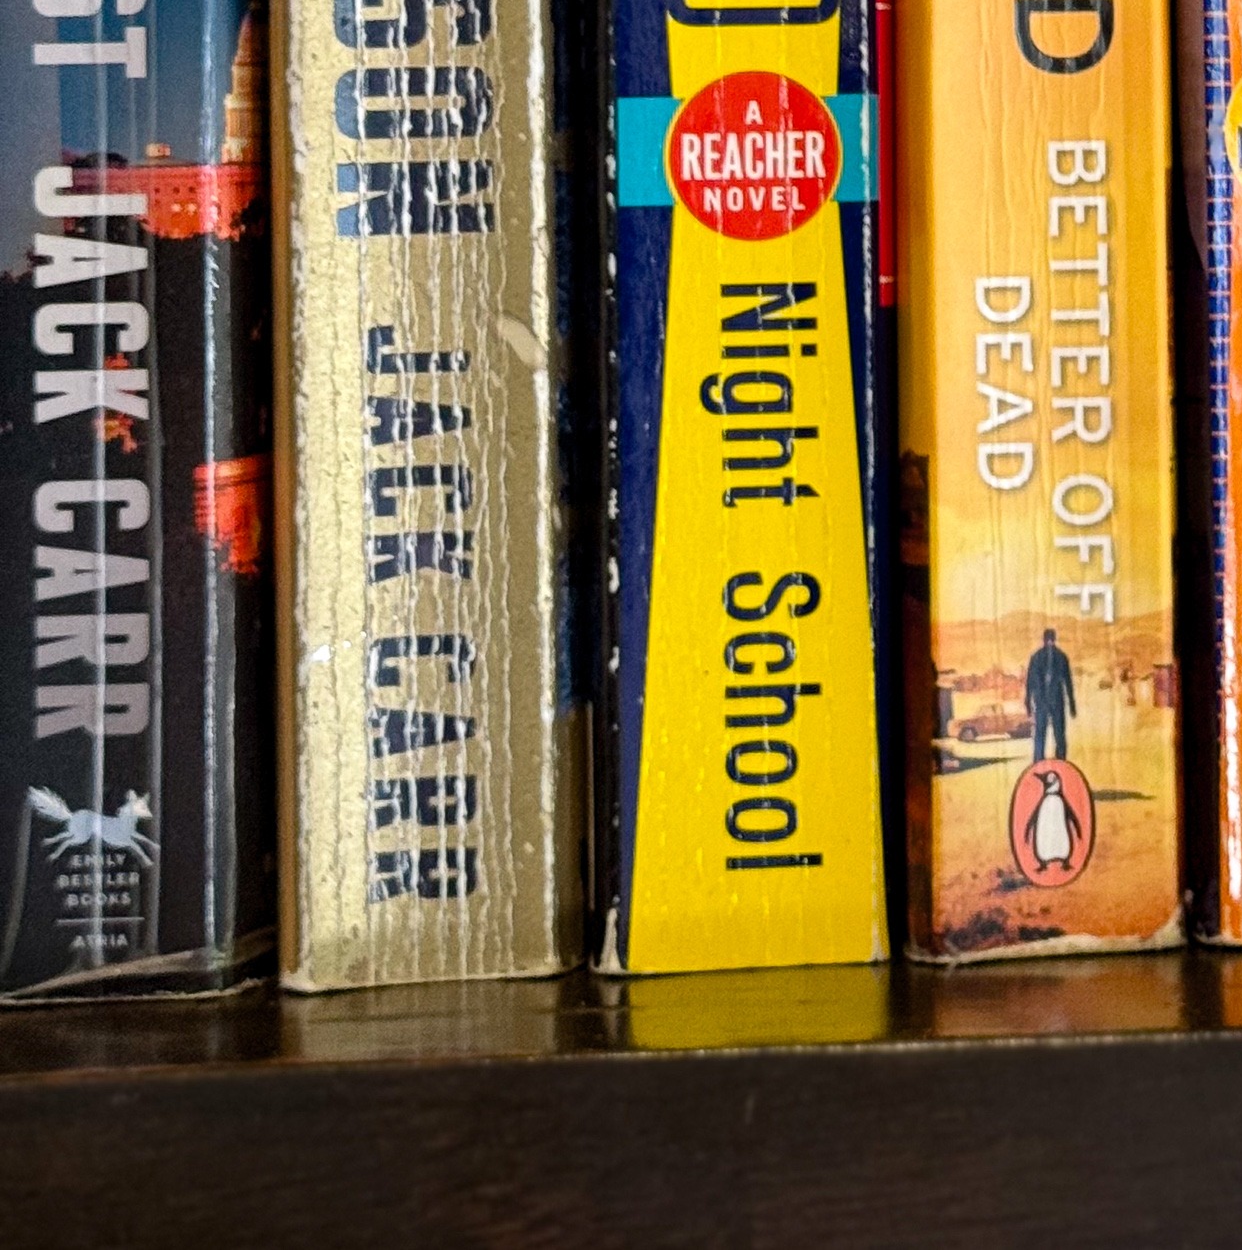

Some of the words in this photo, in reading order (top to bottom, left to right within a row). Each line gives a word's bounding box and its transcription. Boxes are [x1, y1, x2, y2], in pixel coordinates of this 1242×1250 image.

[680, 130, 826, 181] REACHER
[703, 185, 805, 212] NOVEL
[745, 101, 763, 125] A
[33, 164, 149, 424] JACK
[699, 281, 820, 509] Night
[974, 276, 1035, 492] DEAD
[1047, 139, 1113, 445] BETTER
[364, 324, 473, 585] JACK
[1052, 473, 1116, 626] OFF
[34, 478, 150, 739] CARR
[723, 570, 824, 872] School
[367, 633, 479, 904] CARR
